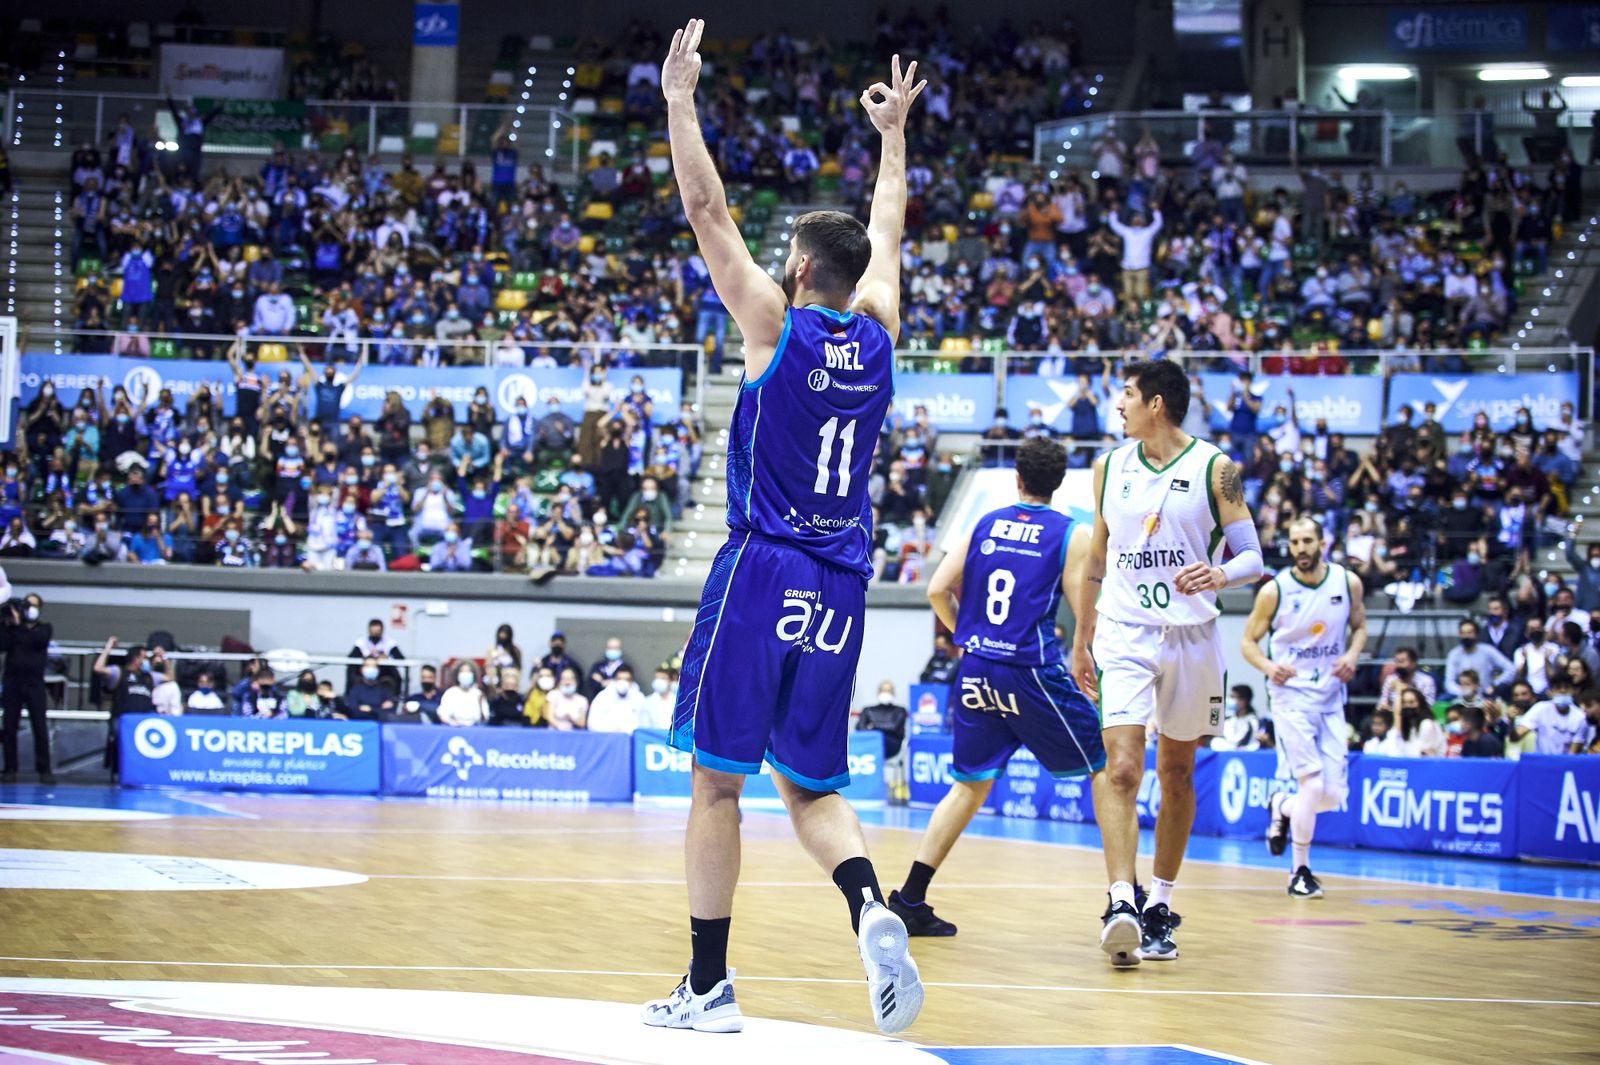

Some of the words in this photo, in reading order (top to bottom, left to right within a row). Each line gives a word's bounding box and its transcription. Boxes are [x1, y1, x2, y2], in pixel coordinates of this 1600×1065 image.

[824, 341, 864, 370] DIEZ
[813, 416, 857, 497] 11
[1116, 549, 1185, 570] PROBITAS
[784, 589, 816, 600] GRUPO
[986, 568, 1016, 626] 8
[1137, 581, 1171, 609] 30
[185, 728, 364, 757] TORREPLAS
[486, 748, 576, 772] Recoletas
[169, 769, 308, 787] www.torreplas.com
